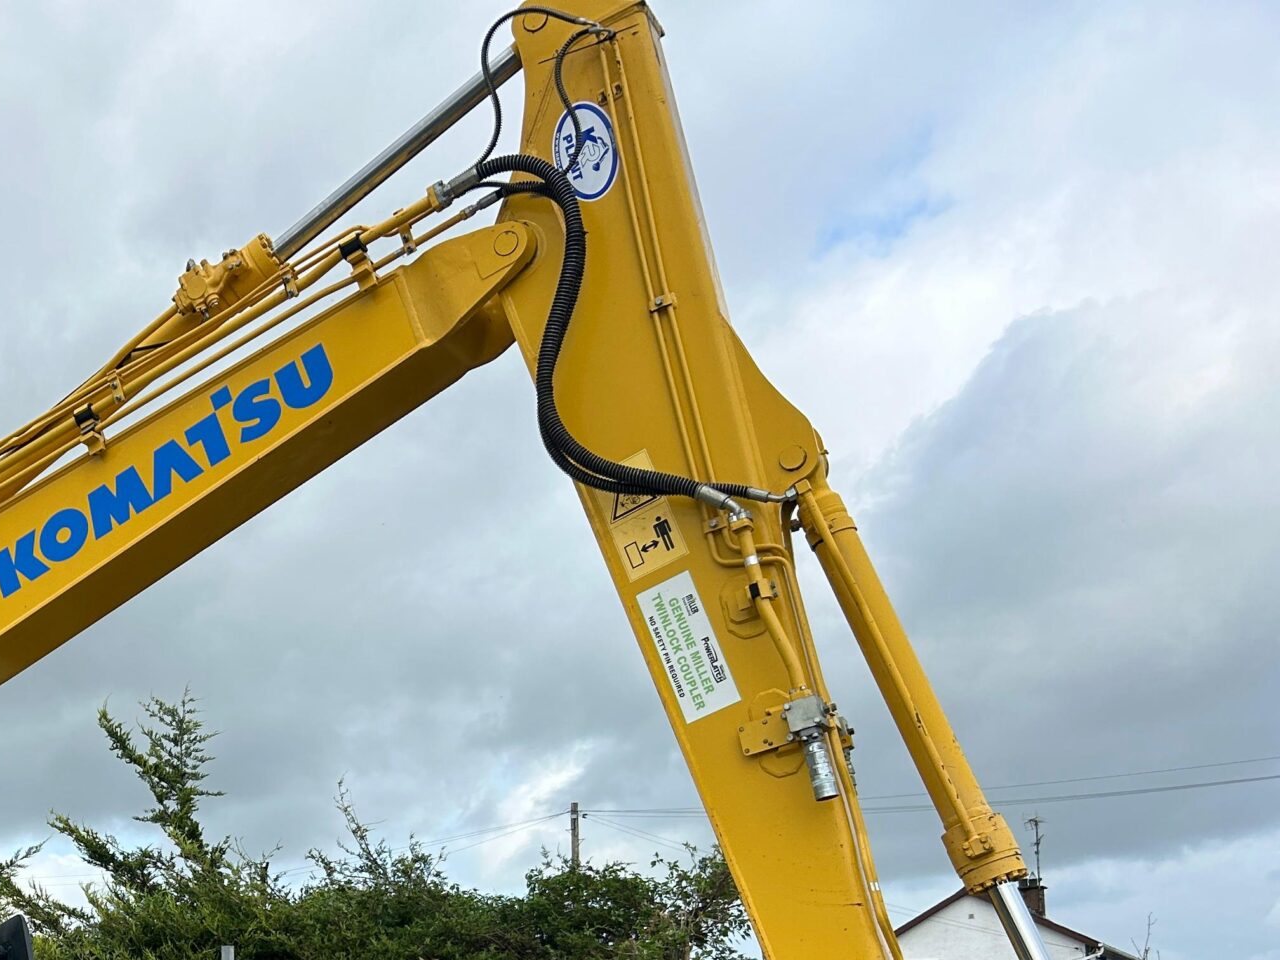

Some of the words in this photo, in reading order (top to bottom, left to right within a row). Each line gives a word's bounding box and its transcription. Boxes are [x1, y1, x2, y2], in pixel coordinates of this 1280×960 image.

[648, 616, 657, 627] NO
[651, 592, 684, 655] TWINLOCK
[677, 655, 706, 711] COUPLER
[652, 626, 667, 652] SAFETY
[668, 597, 697, 650] GENUINE
[689, 650, 715, 695] MILLER
[663, 652, 672, 665] PIN
[667, 664, 686, 698] REQUIRED
